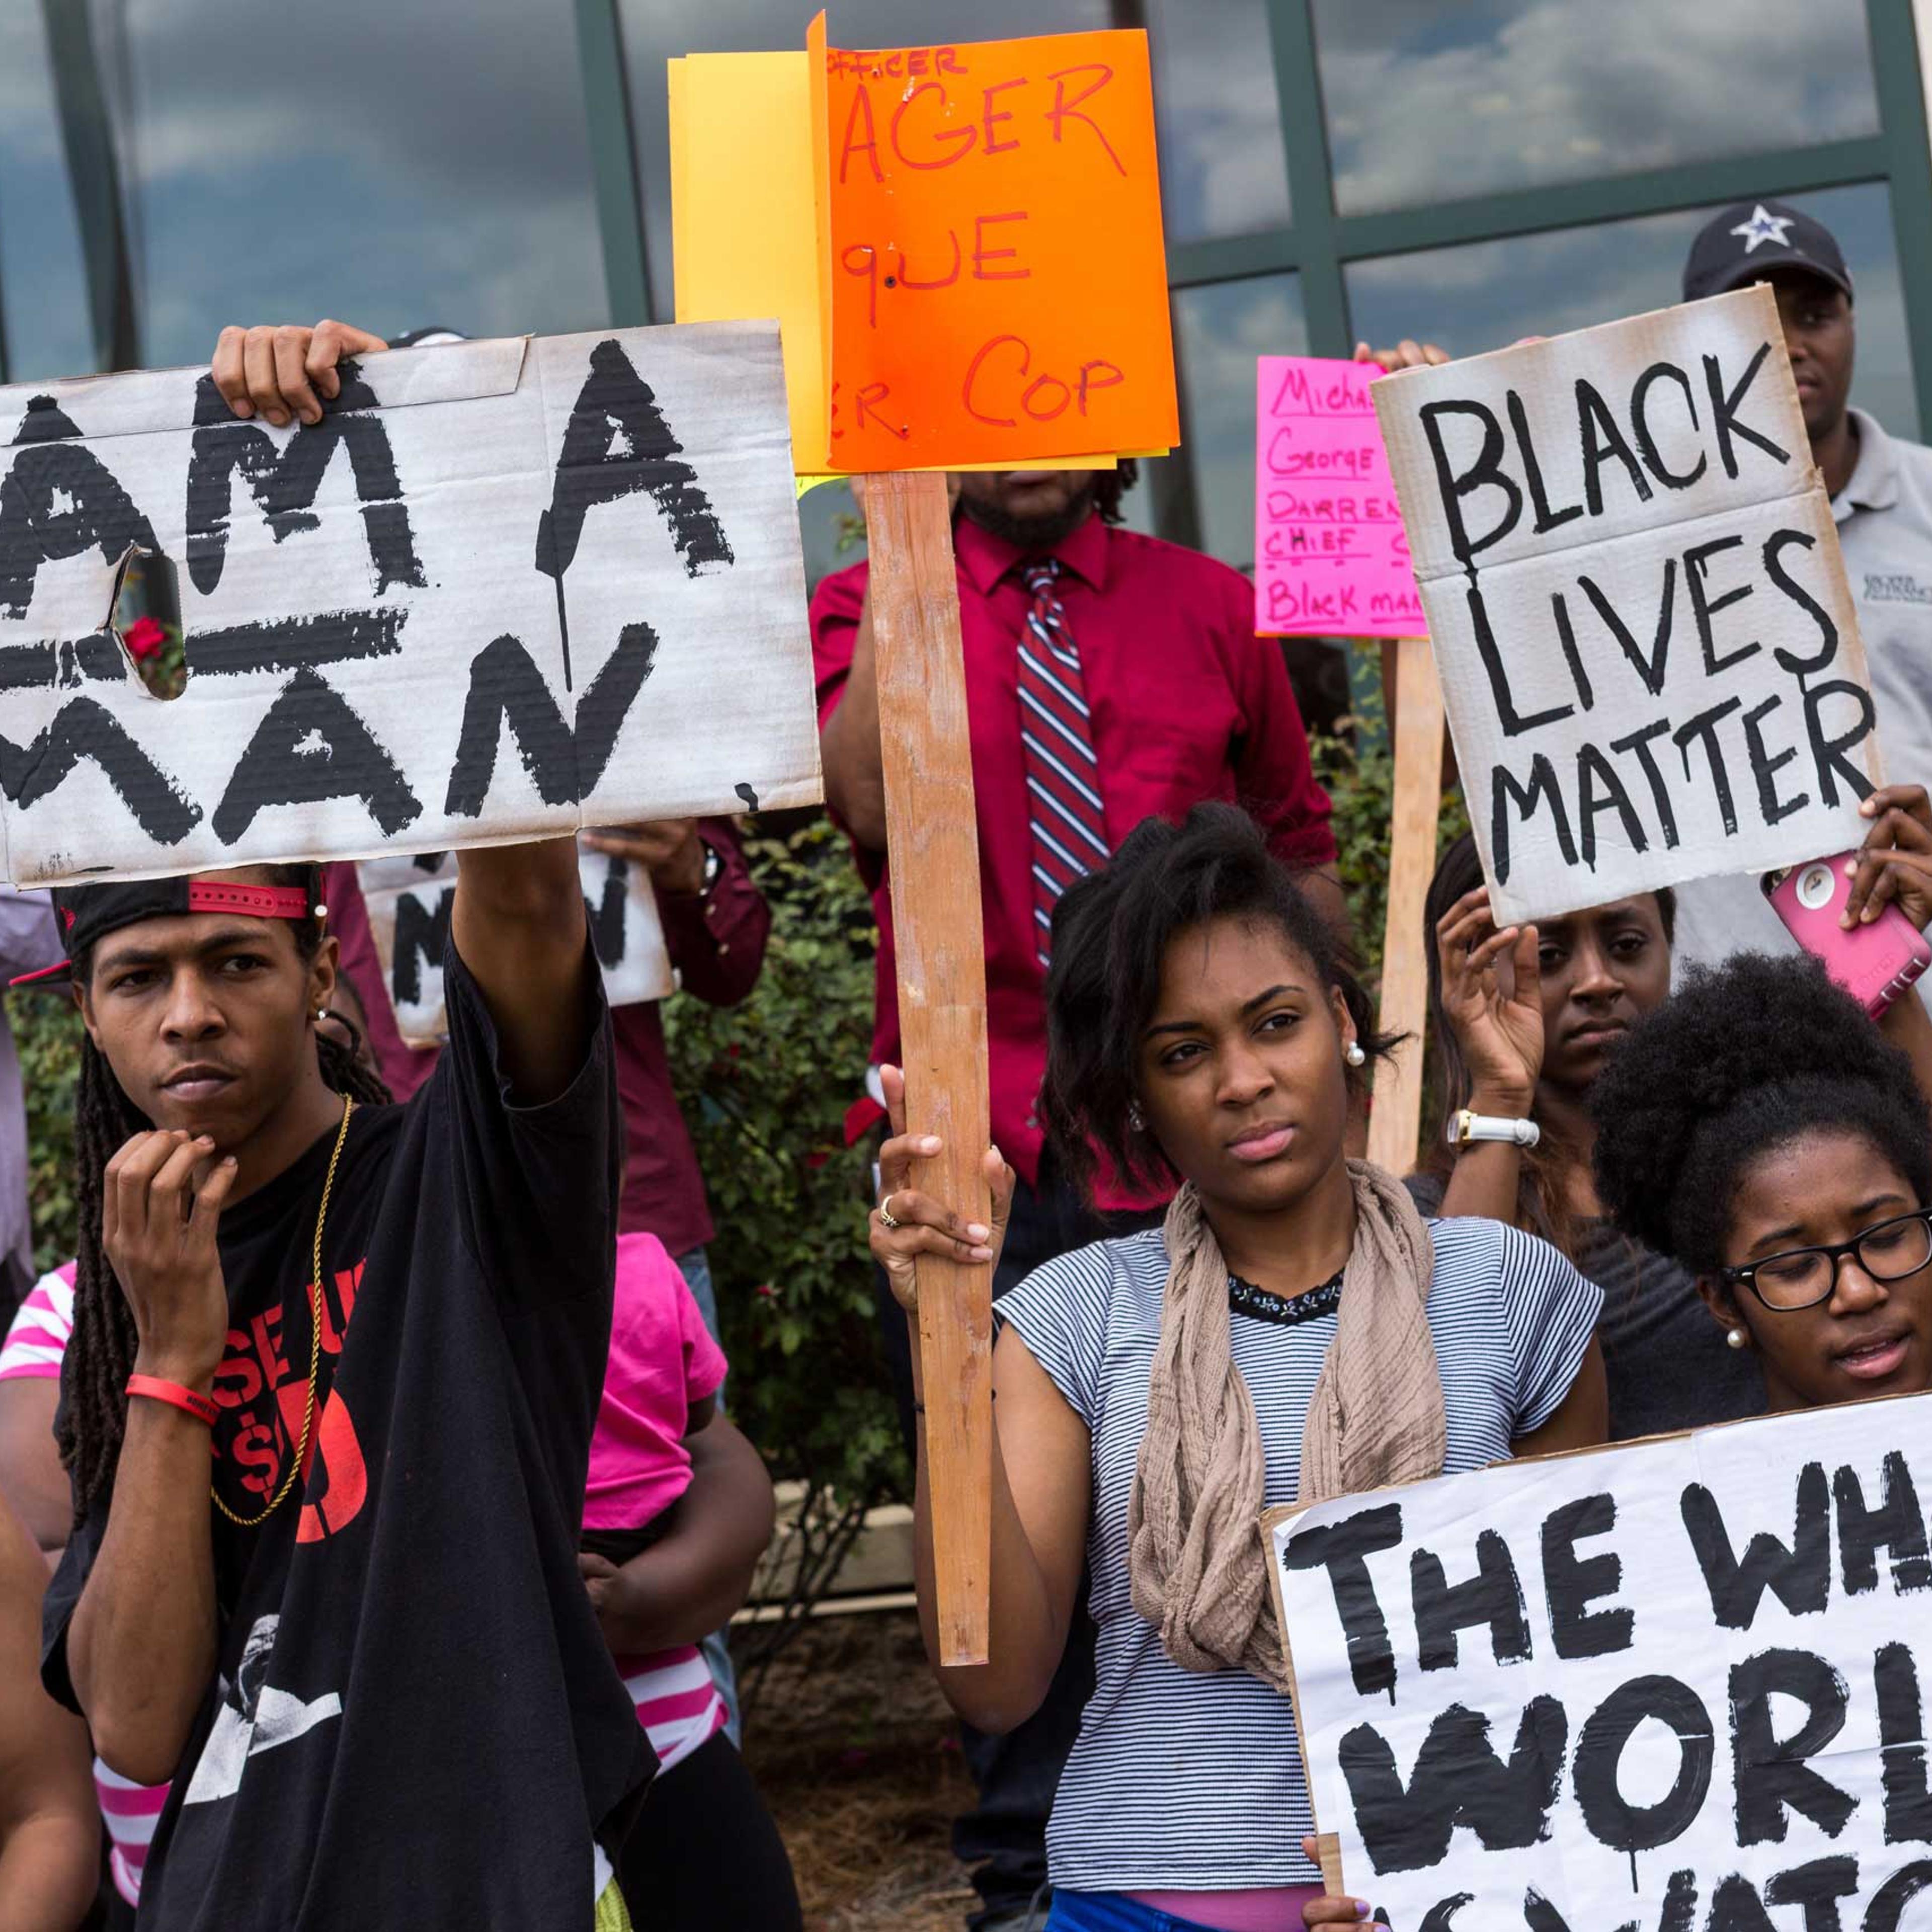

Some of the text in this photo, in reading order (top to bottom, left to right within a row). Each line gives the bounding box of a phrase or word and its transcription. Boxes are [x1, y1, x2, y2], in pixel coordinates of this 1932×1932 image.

[0, 338, 735, 620] AM A
[1419, 342, 1790, 560] BLACK
[1467, 528, 1839, 737] LIVES
[1492, 680, 1878, 887] MATTER
[1283, 1450, 1932, 1698] THE WH
